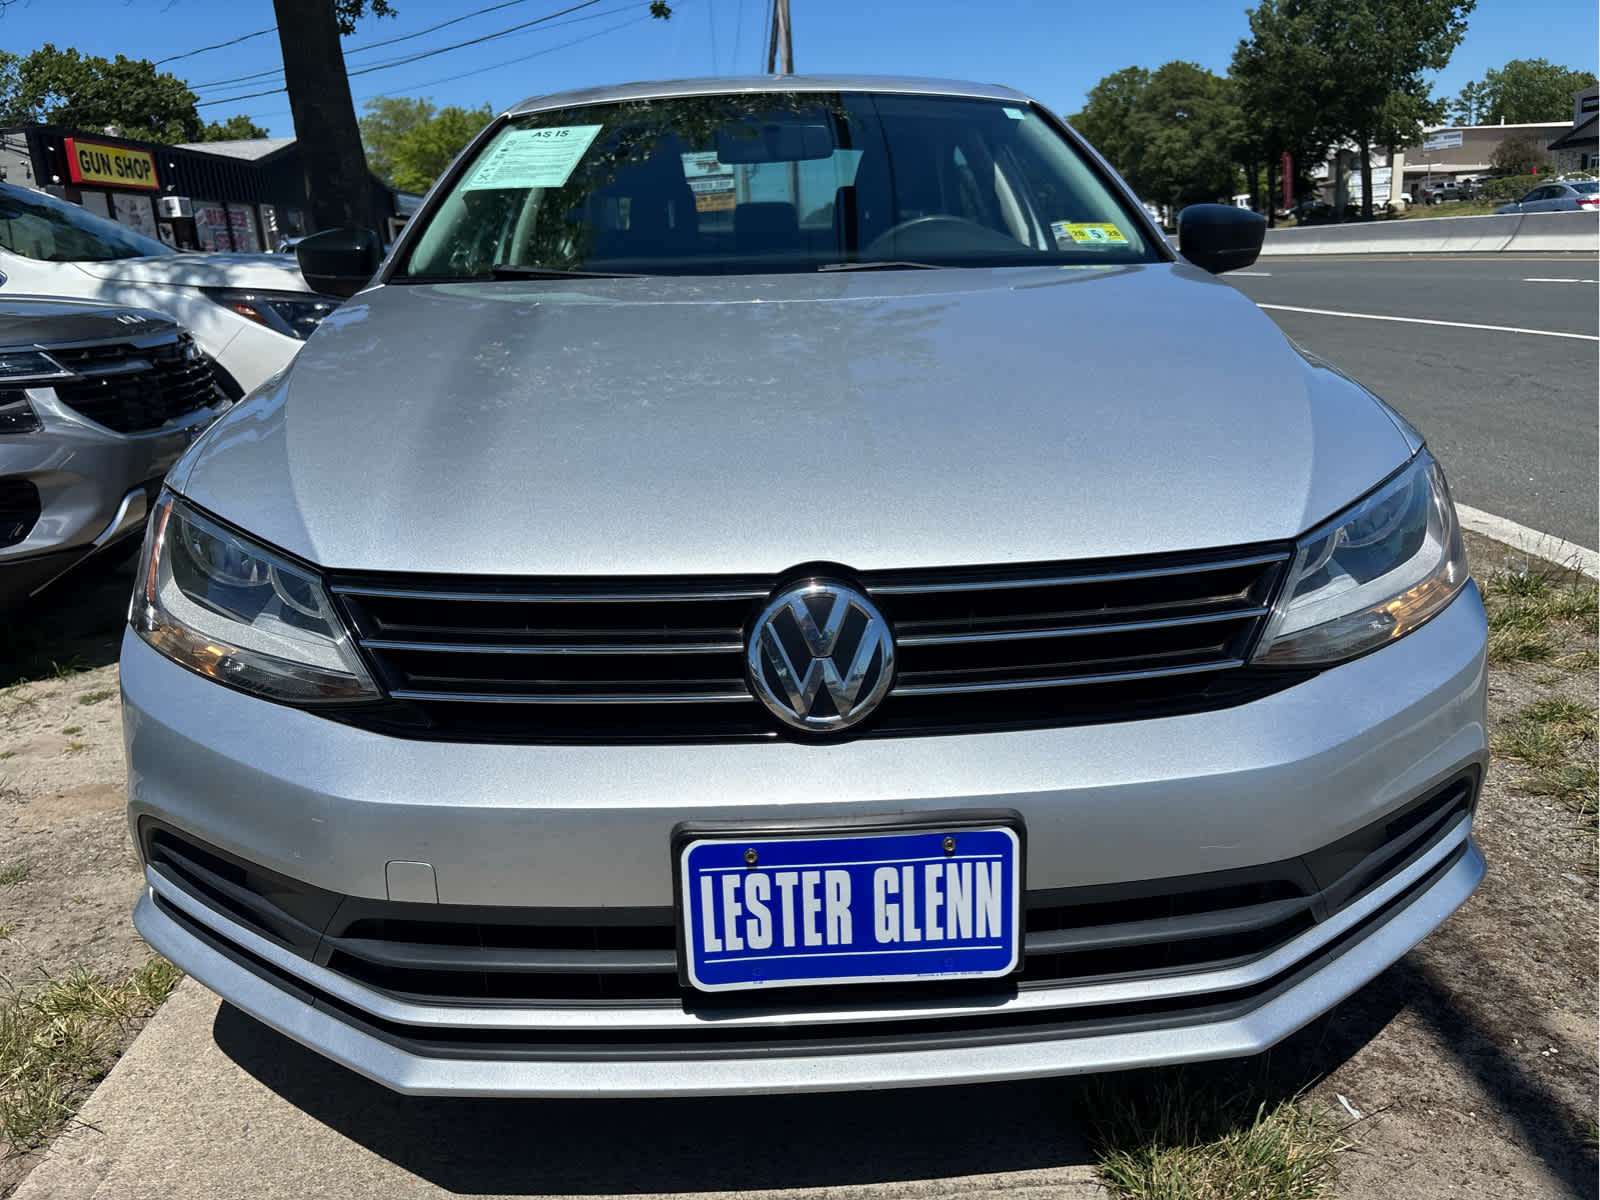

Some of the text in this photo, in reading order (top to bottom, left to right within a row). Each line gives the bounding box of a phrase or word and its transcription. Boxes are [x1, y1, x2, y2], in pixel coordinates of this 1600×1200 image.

[531, 129, 571, 138] AS IS
[79, 150, 152, 182] GUN SHOP
[1089, 229, 1103, 239] 5
[700, 860, 1003, 953] LESTER GLENN
